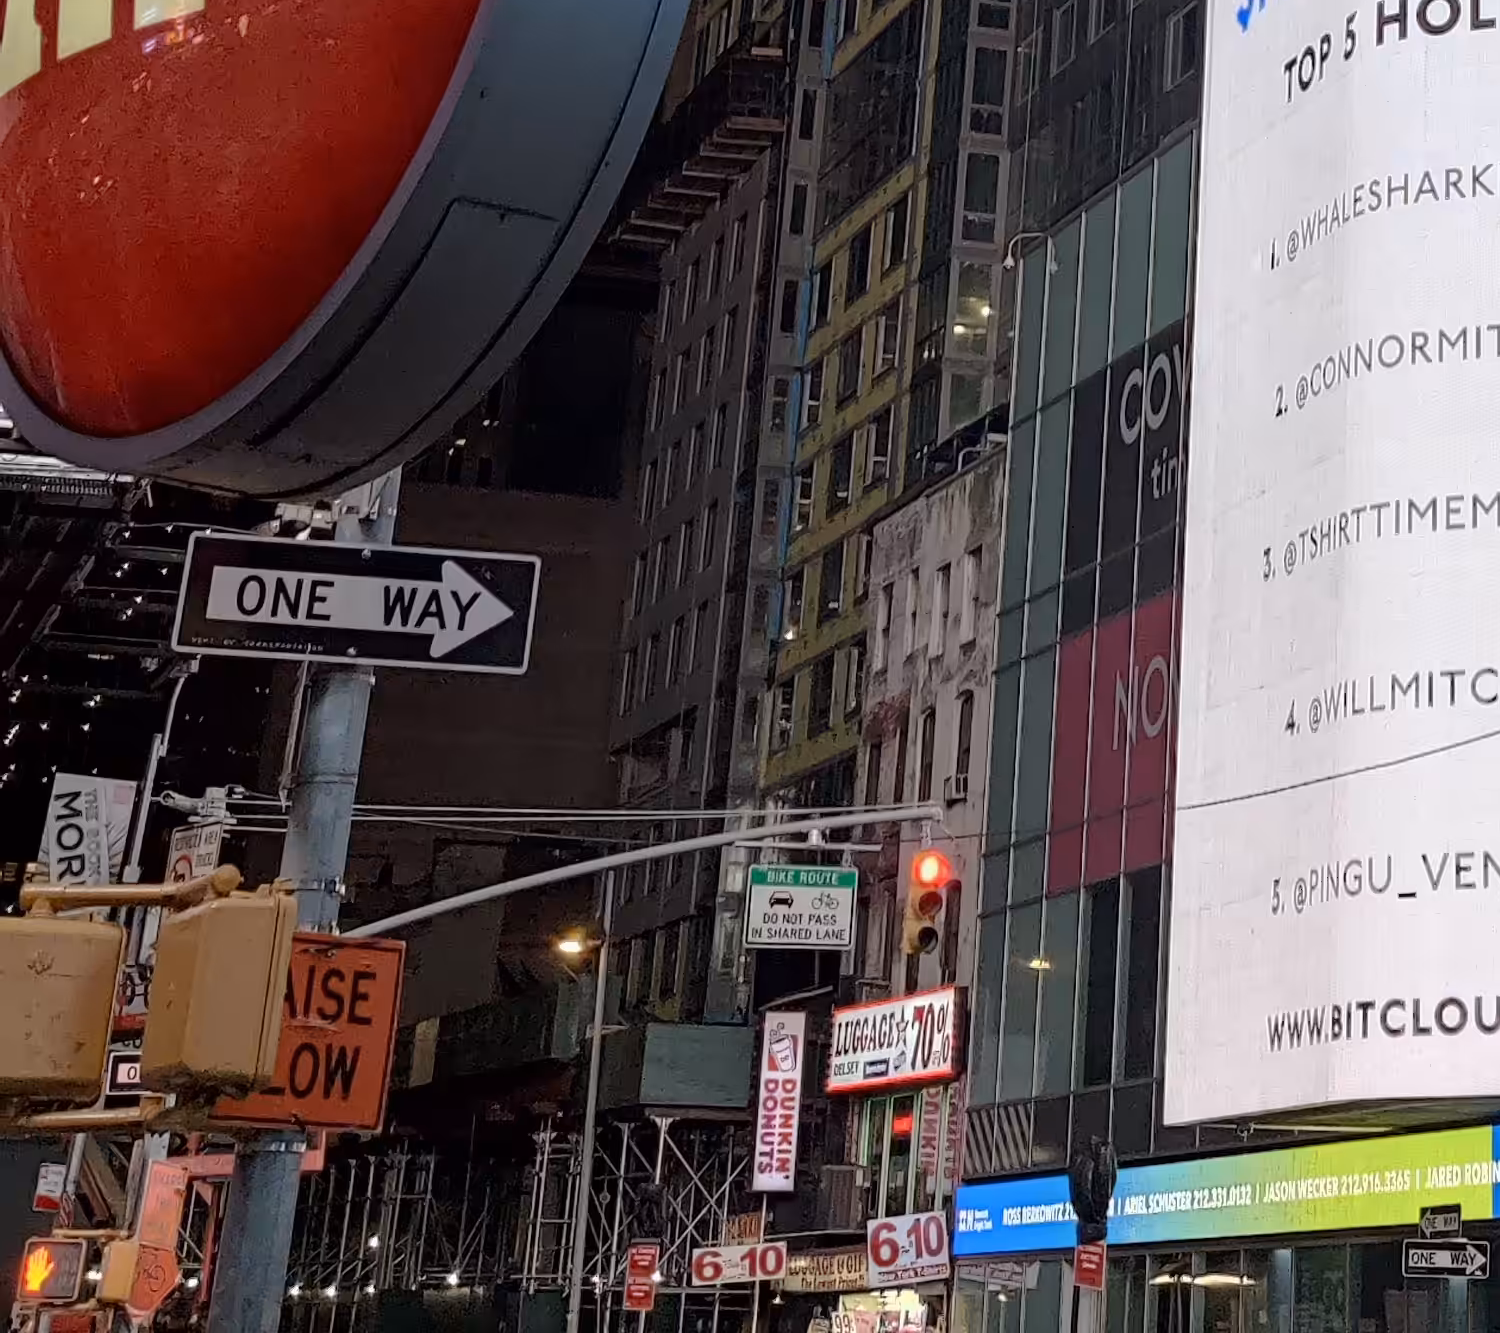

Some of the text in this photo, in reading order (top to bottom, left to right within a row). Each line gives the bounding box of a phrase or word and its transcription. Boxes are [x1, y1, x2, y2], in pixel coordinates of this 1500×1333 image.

[1283, 32, 1332, 104] TOP
[1342, 9, 1358, 63] 5
[1273, 383, 1289, 419] 2.
[1261, 546, 1277, 583] 3.
[236, 574, 481, 632] ONE WAY
[1284, 700, 1300, 738] 4.
[767, 869, 840, 885] BIKE ROUTE
[1270, 878, 1286, 916] 5.
[751, 927, 847, 942] IN SHARED LANE
[762, 913, 838, 927] DO NOT PASS
[281, 962, 375, 1027] AISE
[833, 999, 950, 1071] LUGGAGE 70%
[833, 1060, 860, 1077] DELSEY
[757, 1078, 780, 1176] DONUTS
[774, 1078, 797, 1181] DUNKIN'
[1262, 1181, 1297, 1203] JASON
[1297, 1175, 1340, 1201] WECKER
[1425, 1164, 1460, 1189] JARED
[1002, 1206, 1021, 1226] ROSS
[1123, 1194, 1147, 1217] ARIEL
[1148, 1189, 1192, 1215] SCHUSTER
[870, 1222, 900, 1268] 6
[906, 1215, 945, 1260] 10
[1411, 1250, 1478, 1266] ONE WAY
[692, 1250, 724, 1283] 6
[740, 1245, 785, 1276] 10
[788, 1255, 835, 1276] LUGGAGE
